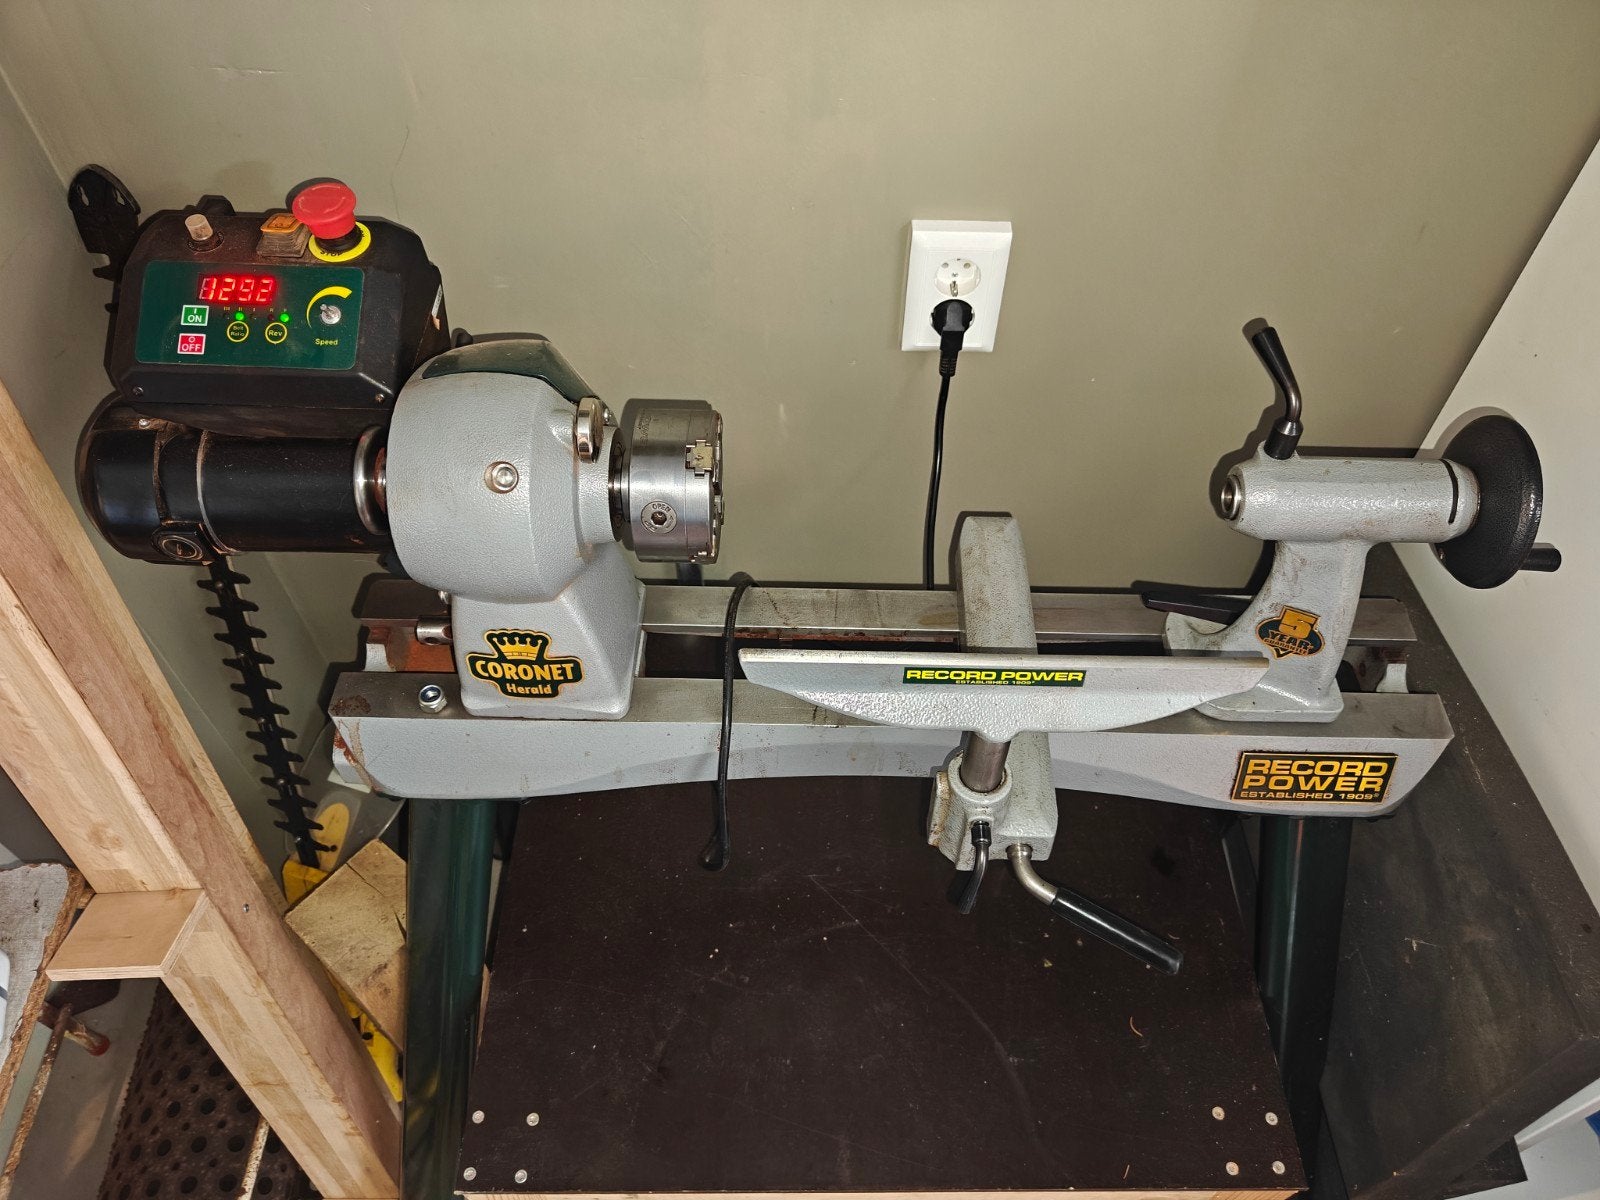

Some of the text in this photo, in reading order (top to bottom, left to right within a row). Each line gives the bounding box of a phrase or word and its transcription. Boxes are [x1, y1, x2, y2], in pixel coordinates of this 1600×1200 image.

[187, 314, 203, 323] ON
[268, 329, 283, 337] Rev
[315, 338, 339, 346] Speed
[181, 344, 201, 353] OFF
[652, 503, 671, 512] OPEN
[1278, 609, 1317, 639] 5
[475, 660, 575, 681] CORONET
[906, 670, 1084, 682] RECORD POWER
[506, 683, 552, 695] Herald
[1246, 759, 1388, 777] RECORD
[1242, 775, 1384, 792] POWER
[1240, 791, 1334, 799] ESTABLISHED
